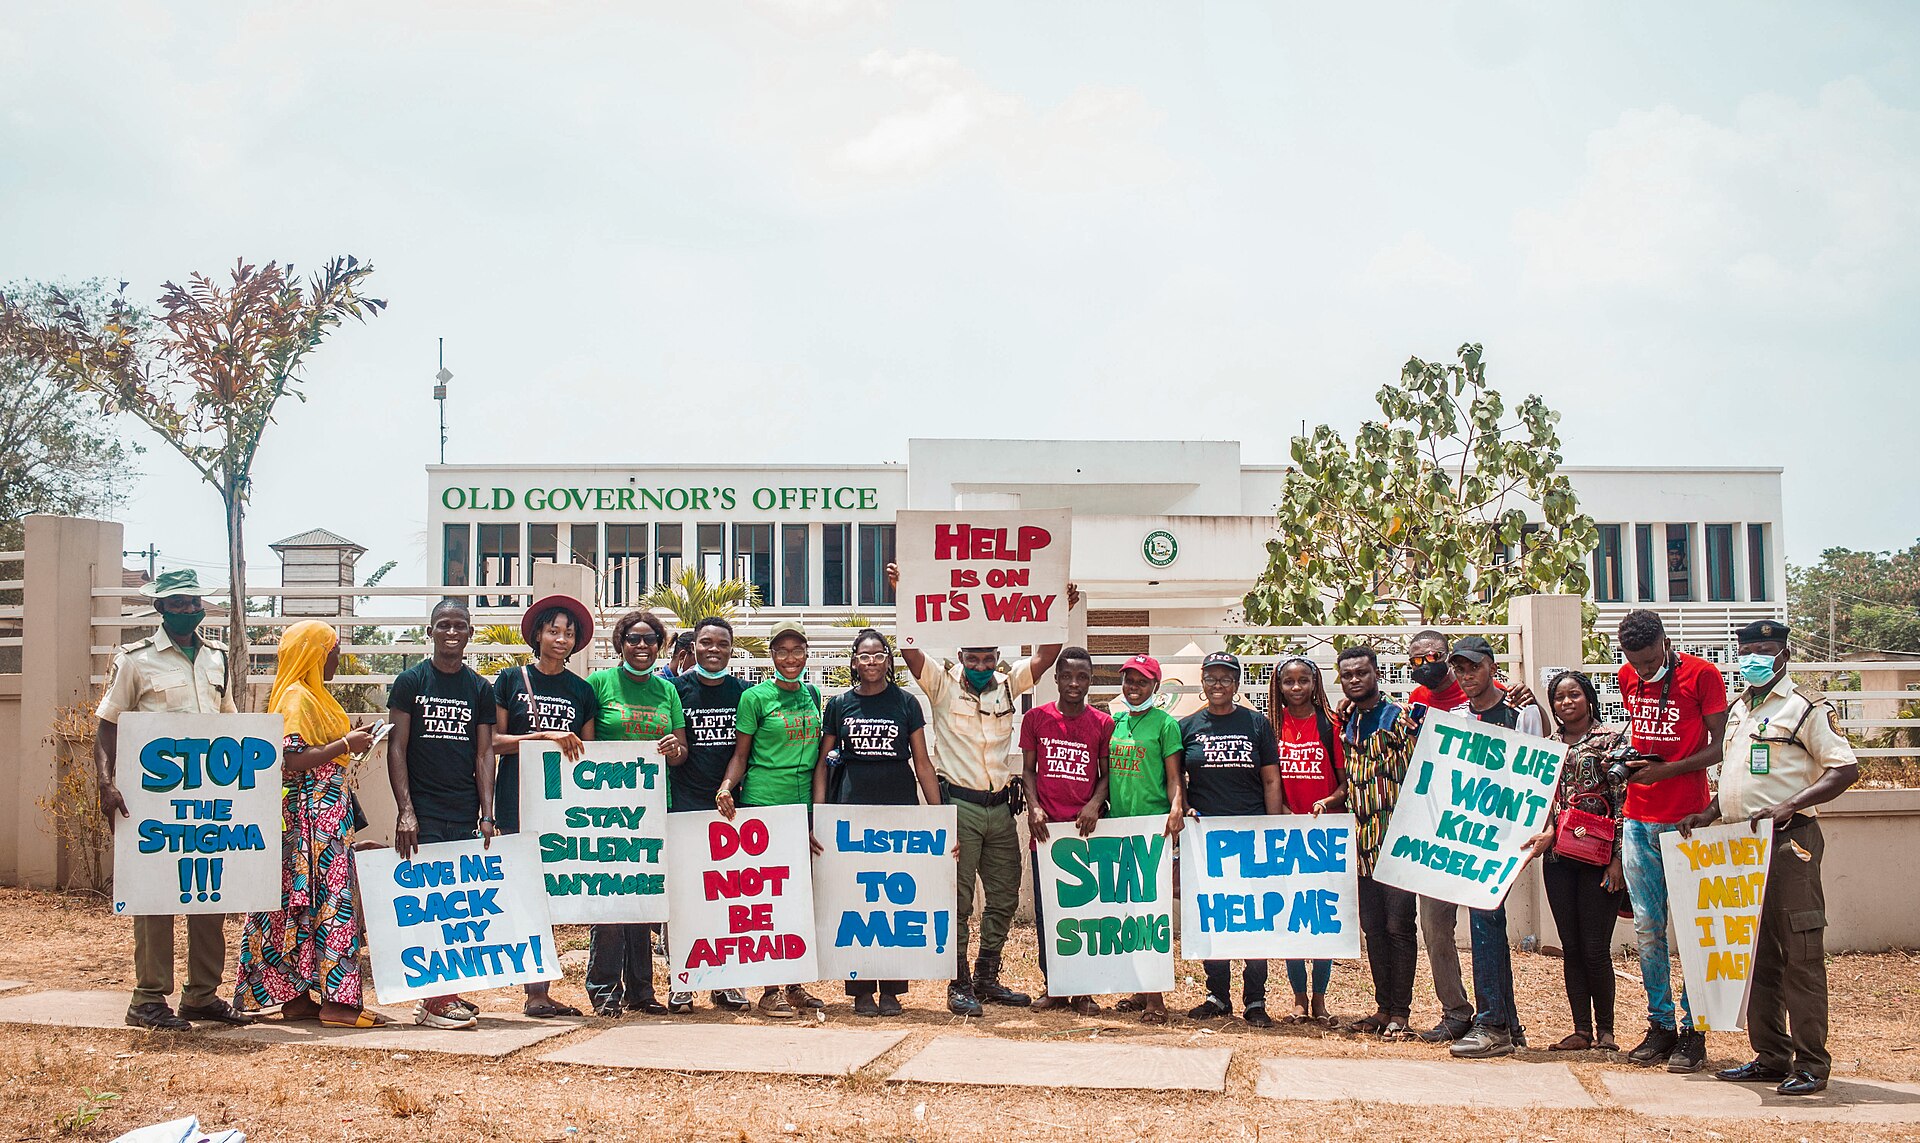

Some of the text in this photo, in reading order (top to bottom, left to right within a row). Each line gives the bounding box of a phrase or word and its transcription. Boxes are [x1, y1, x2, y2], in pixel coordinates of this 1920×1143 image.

[442, 487, 879, 511] OLD GOVERNOR'S OFFICE
[935, 524, 1051, 562] HELP
[951, 569, 1030, 588] IS ON
[916, 591, 1057, 622] IT'S WAY
[422, 705, 472, 722] LET'S
[527, 701, 576, 719] LET'S
[529, 715, 573, 731] TALK
[621, 710, 669, 724] LET'S
[1633, 705, 1680, 721] LET'S
[424, 720, 467, 734] TALK
[622, 722, 667, 736] TALK
[694, 728, 737, 741] TALK
[848, 725, 898, 738] LET'S
[1634, 720, 1676, 735] TALK
[851, 738, 894, 750] TALK
[1046, 746, 1090, 763] LET'S
[1203, 740, 1253, 751] LET'S
[1204, 750, 1252, 762] TALK
[1279, 748, 1324, 760] LET'S
[1434, 723, 1561, 786] THIS LIFE
[140, 736, 277, 793] STOP
[543, 751, 659, 800] I CAN'T
[1047, 760, 1087, 775] TALK
[1280, 761, 1321, 773] TALK
[1414, 761, 1548, 827] I WON'T
[170, 799, 233, 821] THE
[564, 806, 646, 830] STAY
[138, 819, 266, 854] STIGMA
[708, 818, 769, 861] DO
[836, 820, 947, 856] LISTEN
[1436, 810, 1499, 851] KILL
[538, 832, 663, 864] SILENT
[1206, 828, 1349, 878] PLEASE
[1676, 837, 1768, 872] YOU DEY
[393, 855, 504, 889] GIVE ME
[1051, 834, 1166, 908] STAY
[1391, 835, 1518, 894] MYSELF!
[178, 857, 223, 904] !!!
[544, 873, 665, 897] ANYMORE
[703, 866, 790, 901] NOT
[856, 871, 917, 905] TO
[1697, 871, 1765, 910] MENT
[393, 888, 504, 927] BACK
[729, 904, 774, 934] BE
[1197, 889, 1342, 935] HELP ME
[441, 920, 490, 945] MY
[1056, 914, 1170, 956] STRONG
[1695, 916, 1716, 948] I
[401, 935, 544, 988] SANITY!
[685, 934, 807, 969] AFRAID
